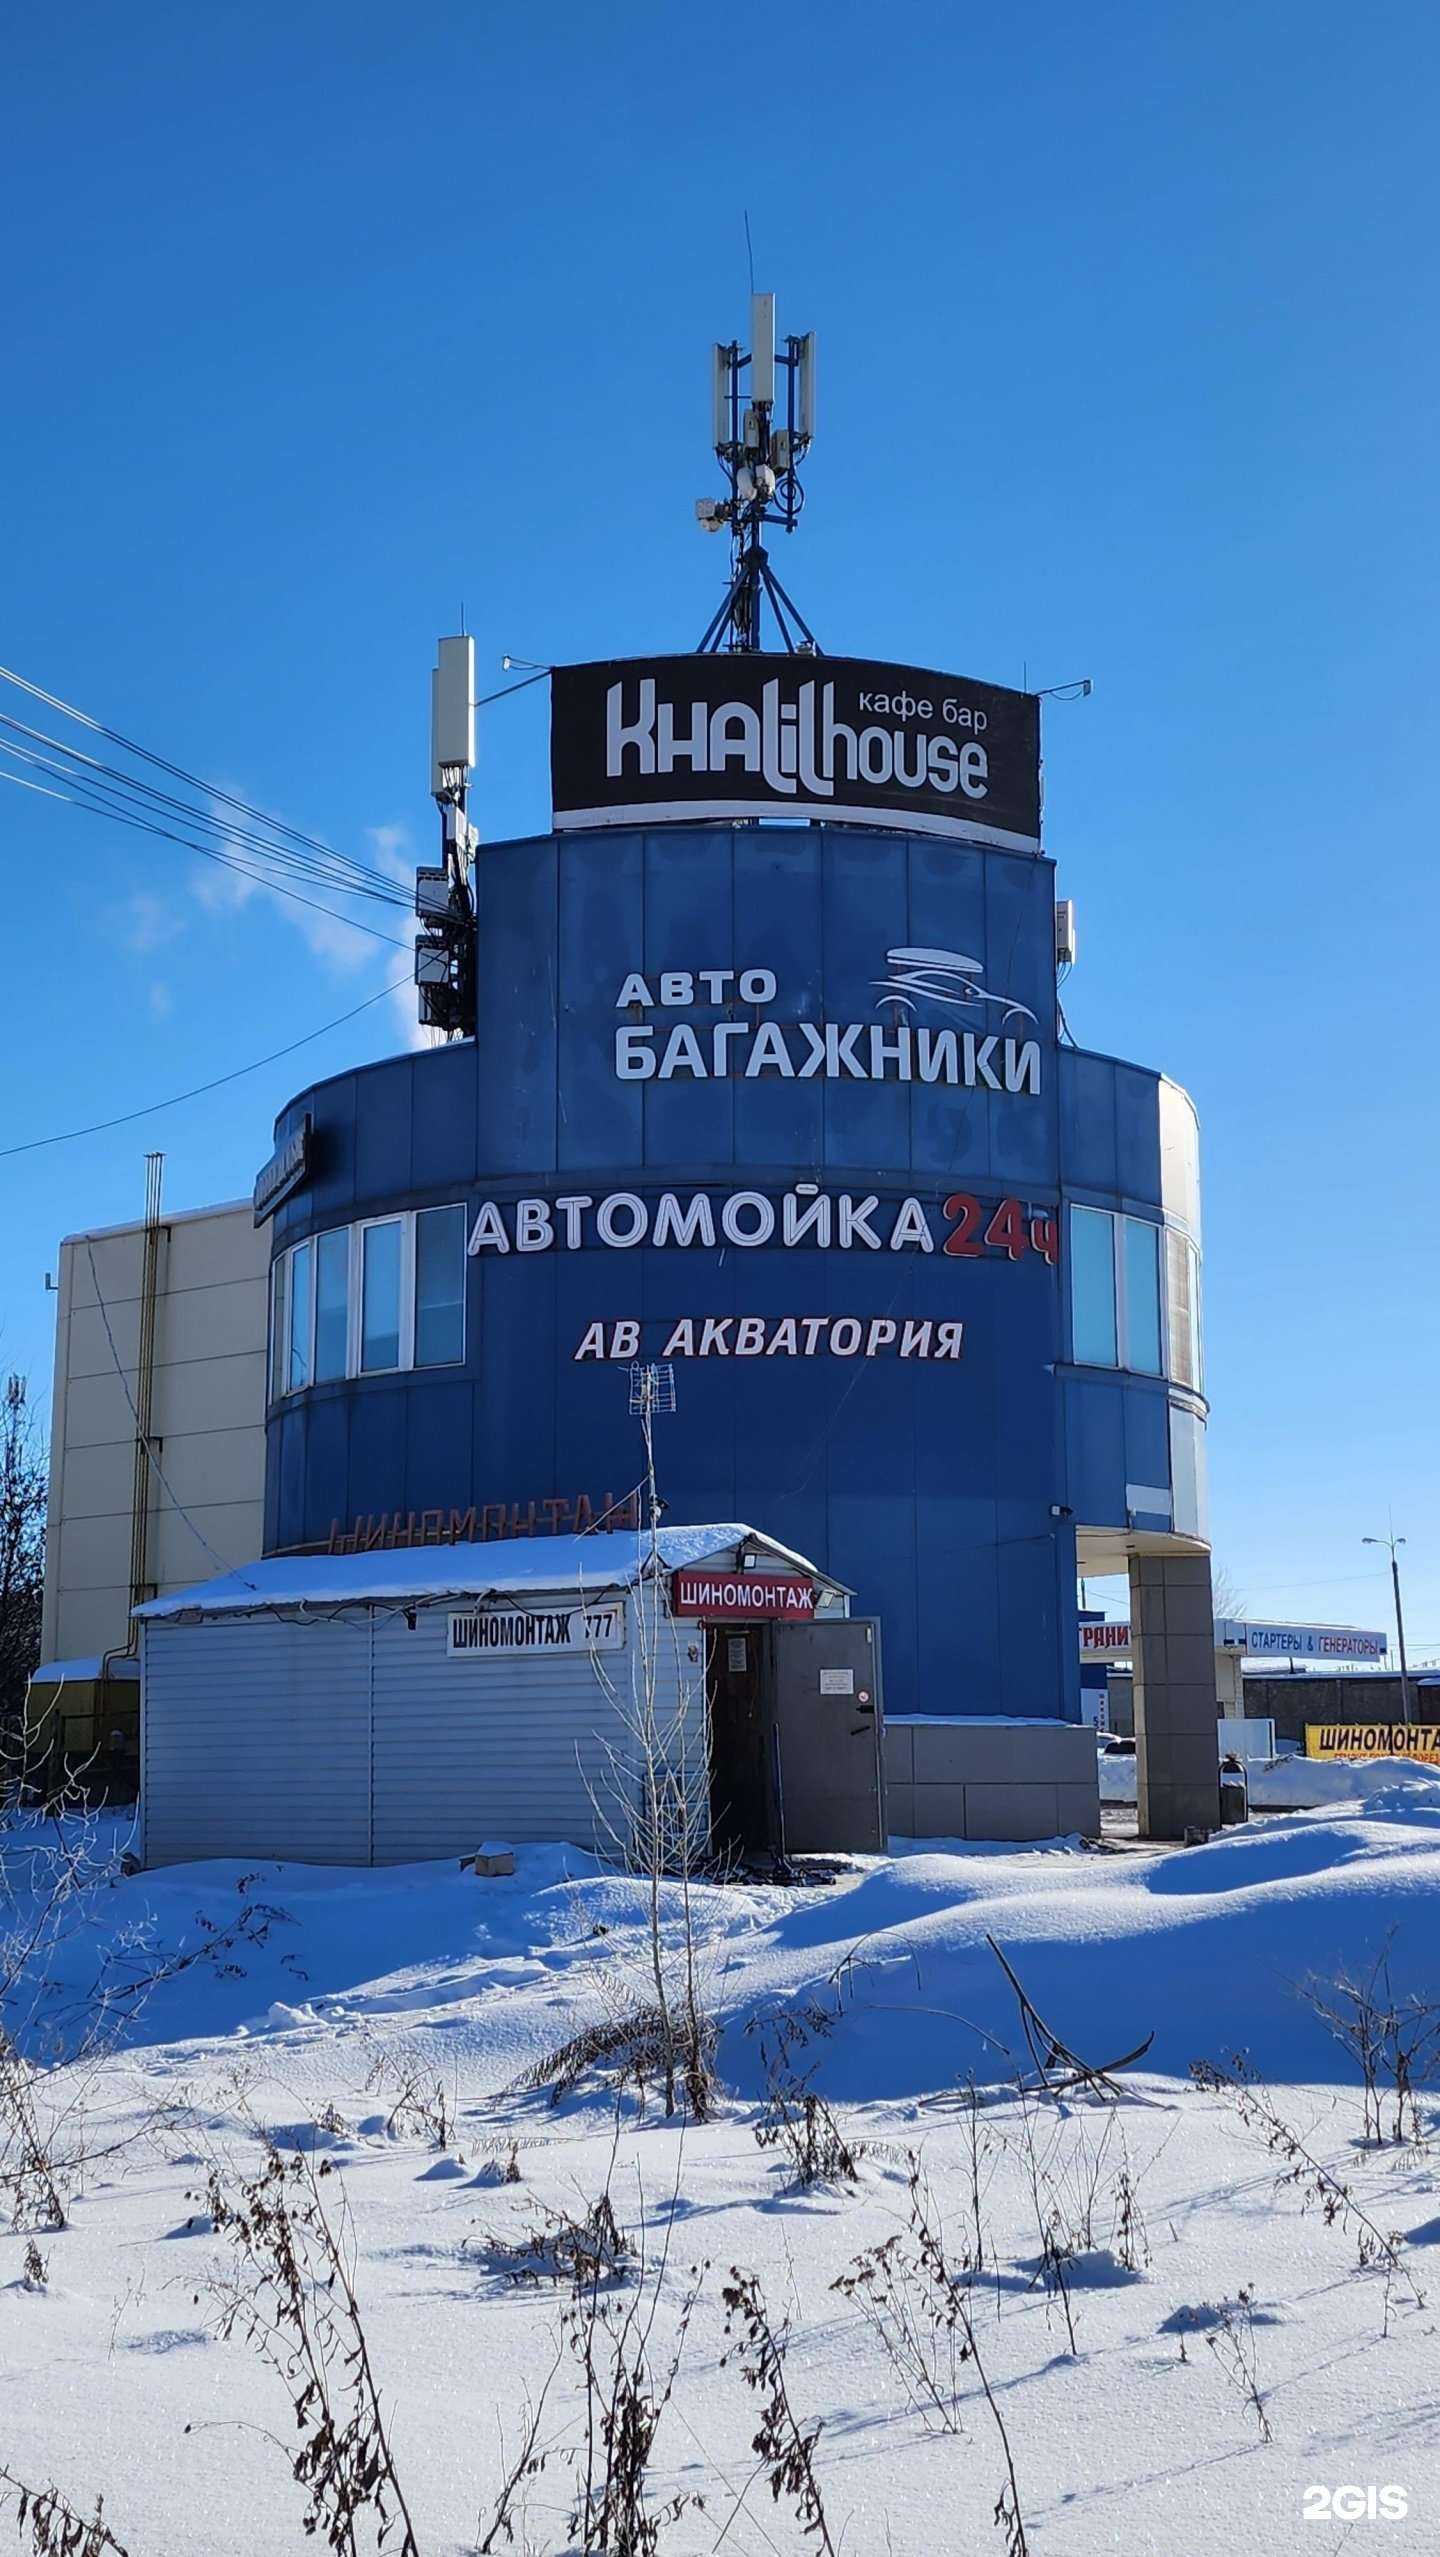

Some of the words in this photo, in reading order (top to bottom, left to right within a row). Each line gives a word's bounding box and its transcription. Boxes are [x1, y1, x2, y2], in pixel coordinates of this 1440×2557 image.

[859, 690, 934, 722] кафе
[942, 698, 988, 735] бар
[616, 969, 777, 1008] АВТО
[615, 1022, 1041, 1096] БАГАЖНИКИ
[467, 1183, 934, 1256] АВТОМОЙКА
[574, 1321, 640, 1360] АВ
[662, 1316, 964, 1359] АКВАТОРИЯ
[680, 1582, 813, 1609] ШИНОМОНТАЖ
[453, 1614, 571, 1648] ШИНОМОНТАЖ
[583, 1613, 613, 1639] 777
[1079, 1625, 1131, 1648] РАНИ
[1251, 1631, 1302, 1650] СТАРТЕРЫ
[1319, 1636, 1378, 1655] ГЕНЕРАТОРЫ
